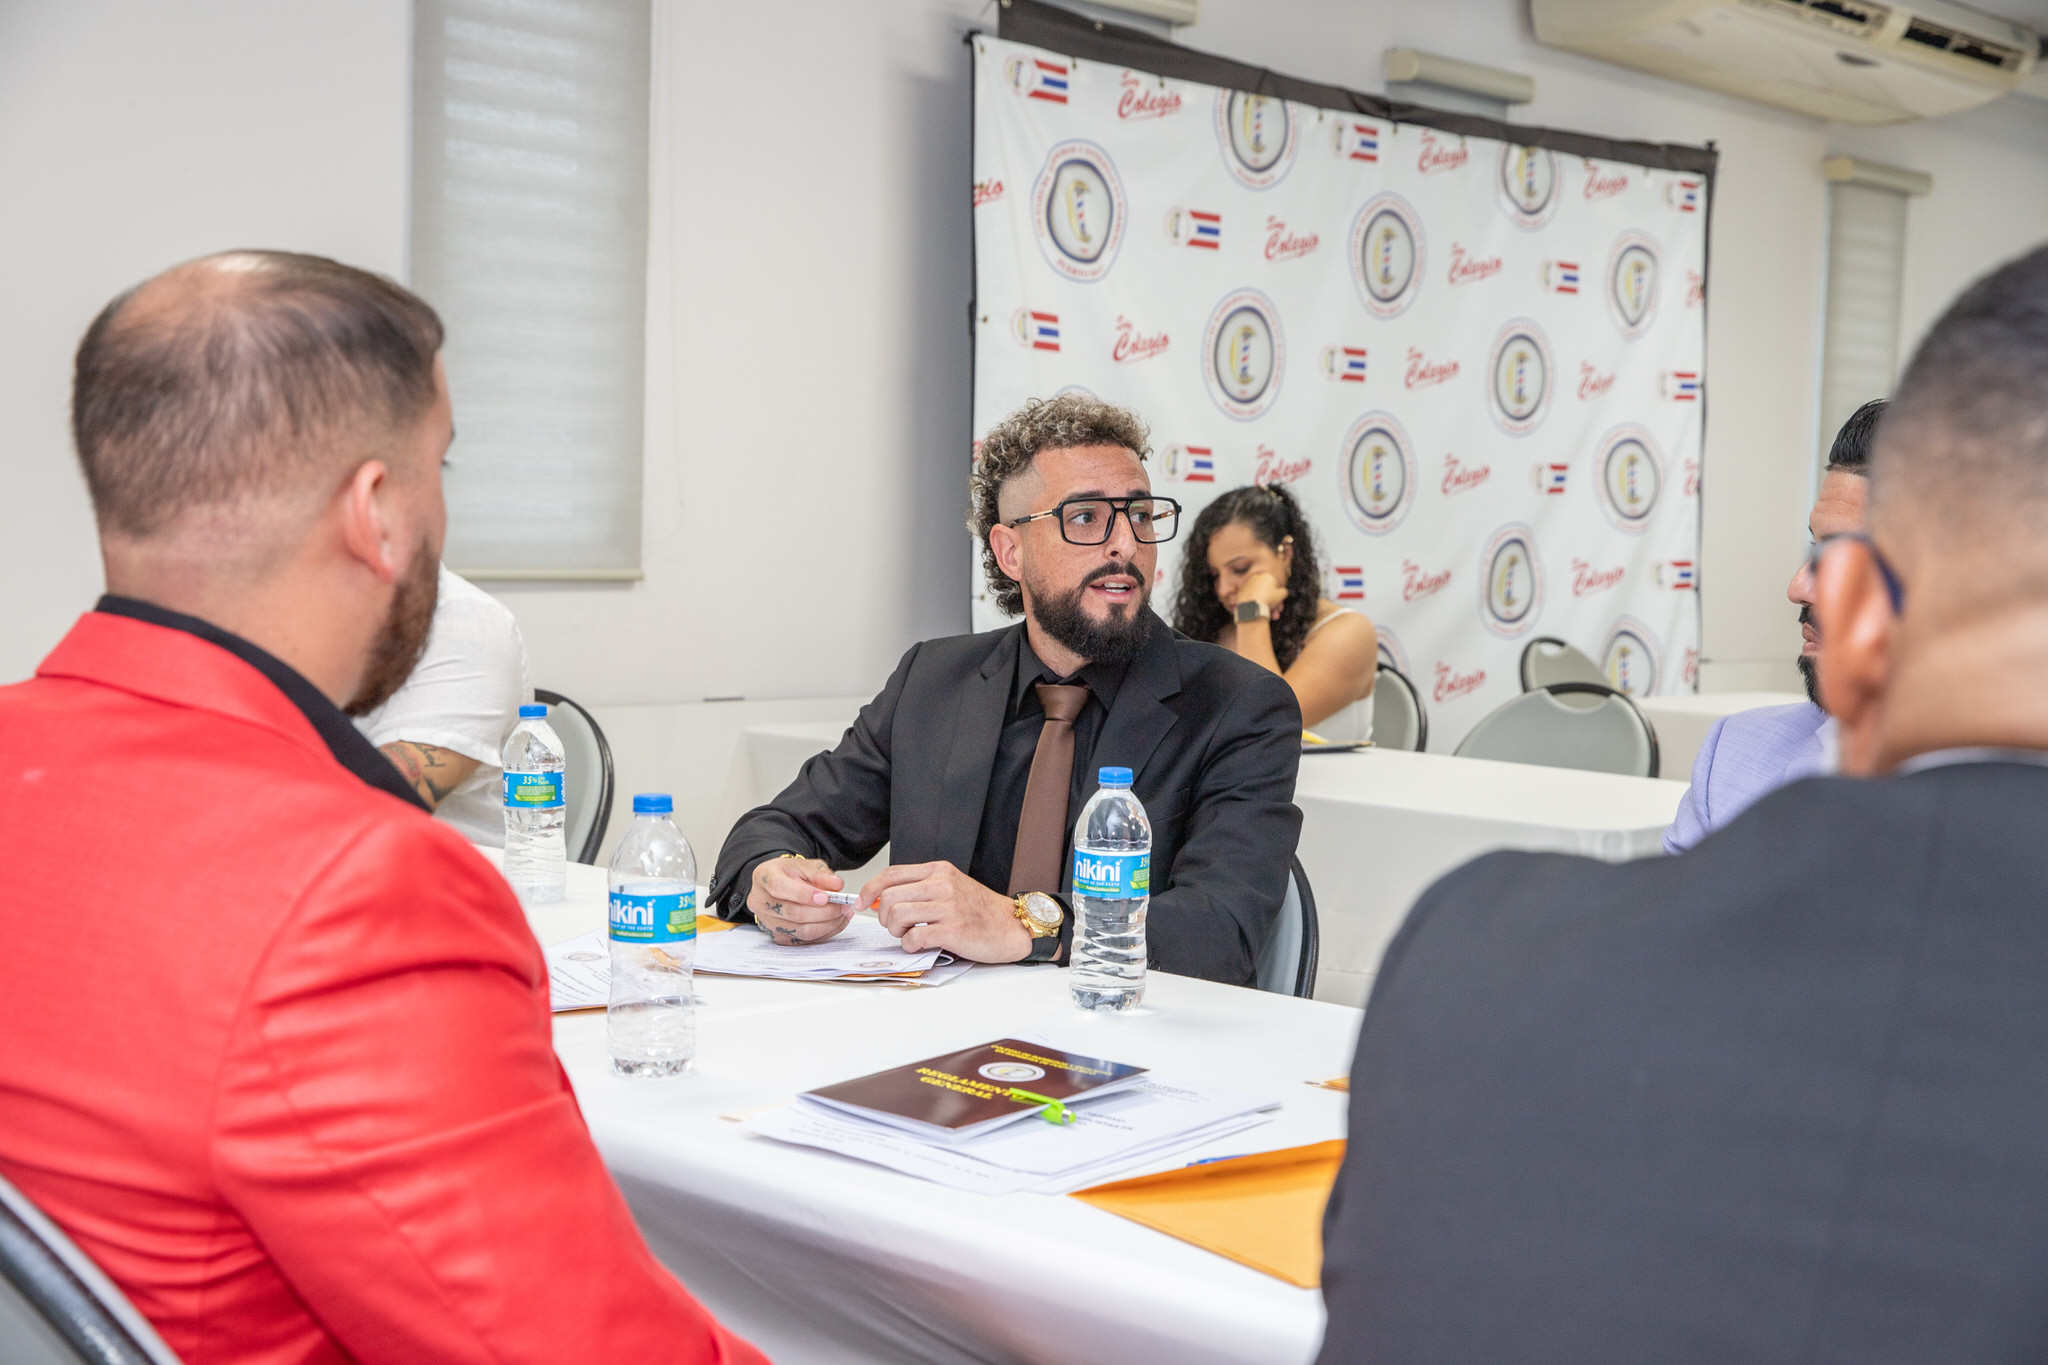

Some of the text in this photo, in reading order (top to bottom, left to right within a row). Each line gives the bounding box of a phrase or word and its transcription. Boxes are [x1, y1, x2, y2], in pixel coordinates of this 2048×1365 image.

[1117, 90, 1182, 120] Colegio
[1264, 231, 1320, 261] Colegio
[1112, 331, 1169, 363] Colegio
